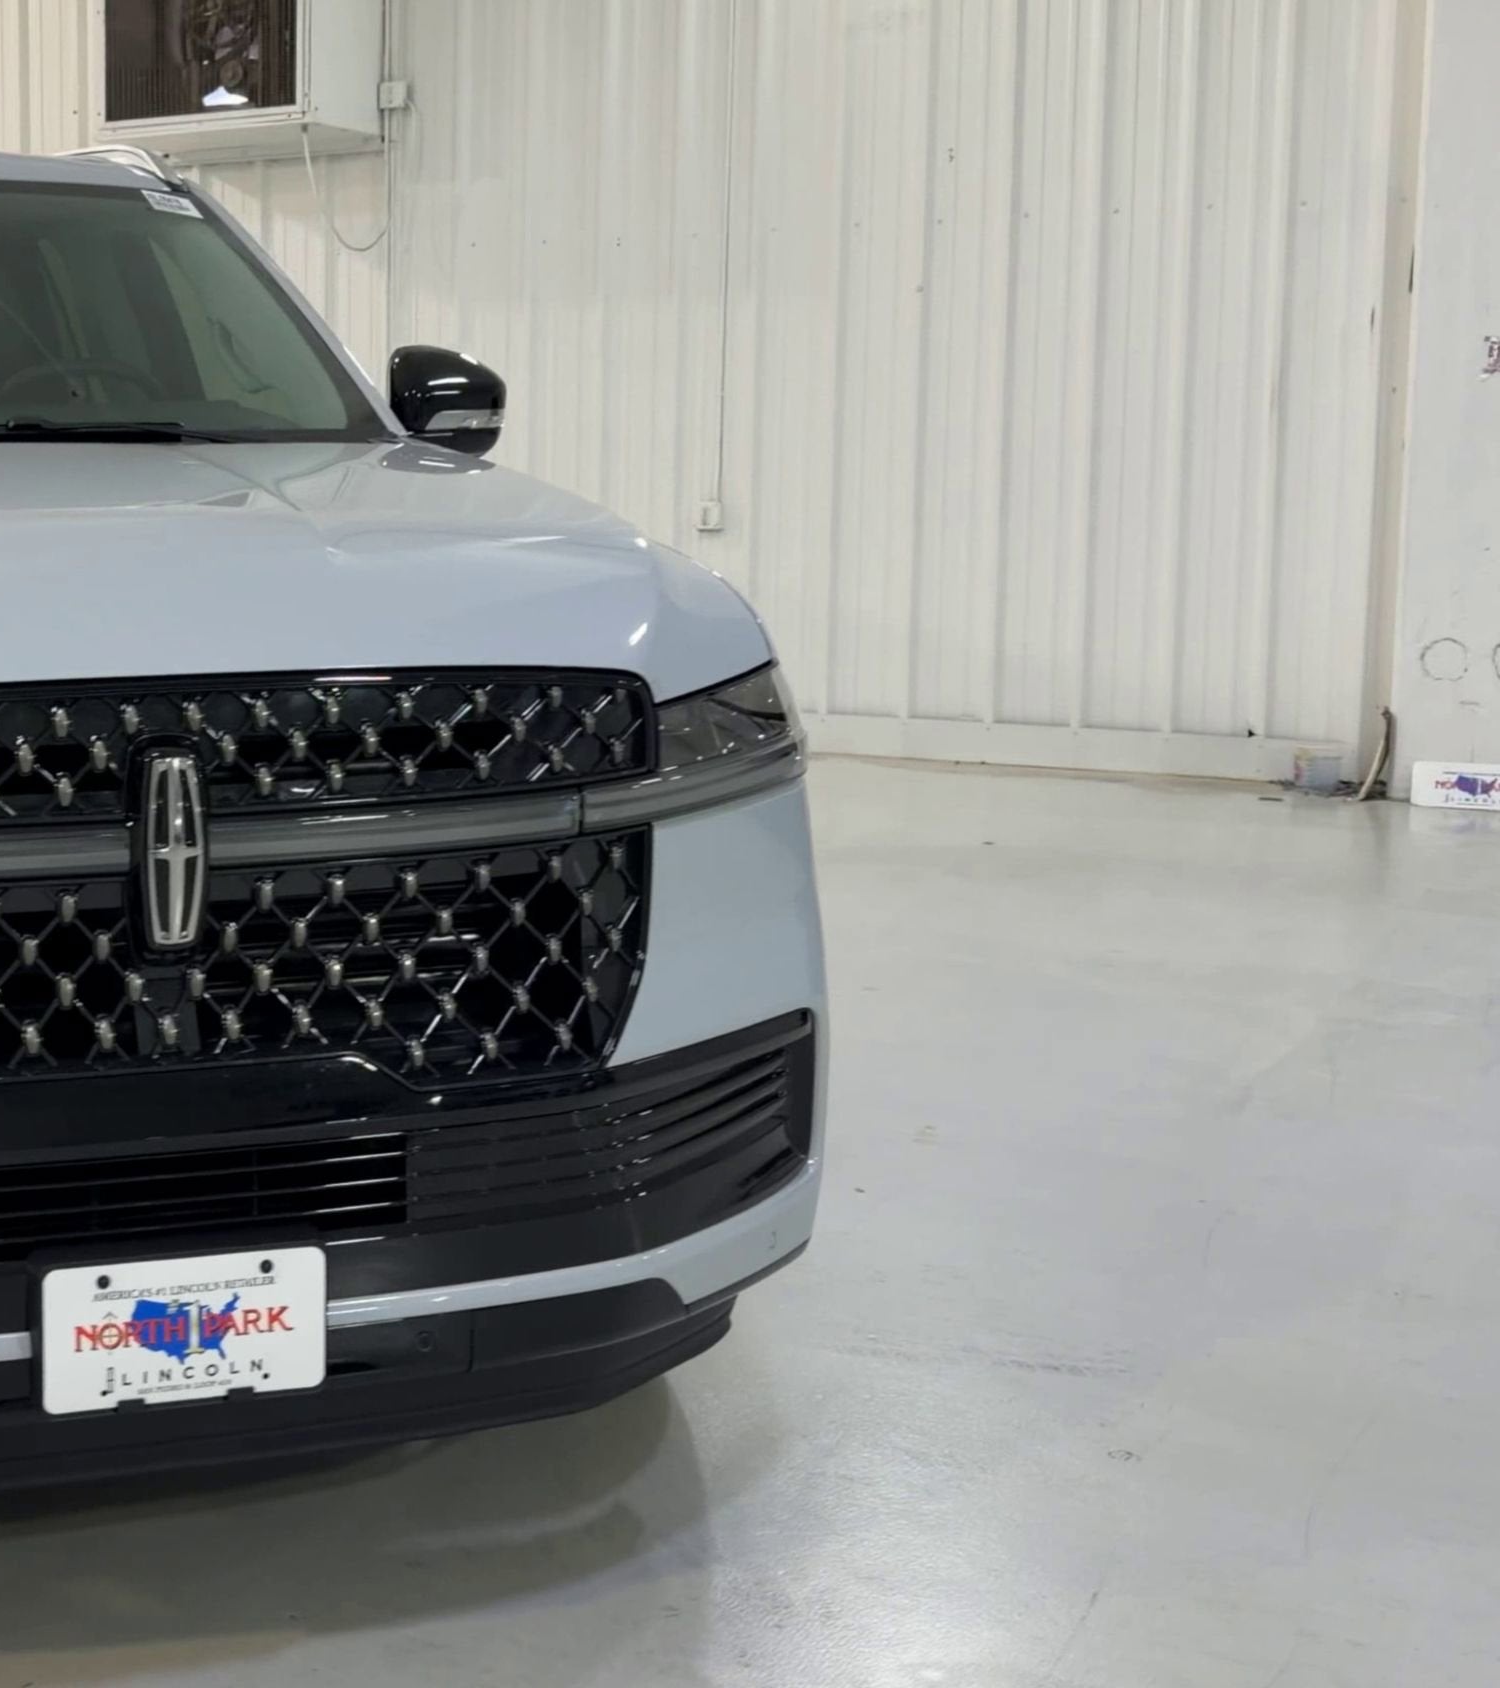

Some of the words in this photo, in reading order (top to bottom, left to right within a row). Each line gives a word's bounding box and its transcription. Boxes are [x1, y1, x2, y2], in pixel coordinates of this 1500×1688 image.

[74, 1316, 186, 1353] NORTH
[202, 1306, 294, 1340] PARK
[121, 1359, 264, 1386] LINCOLN
